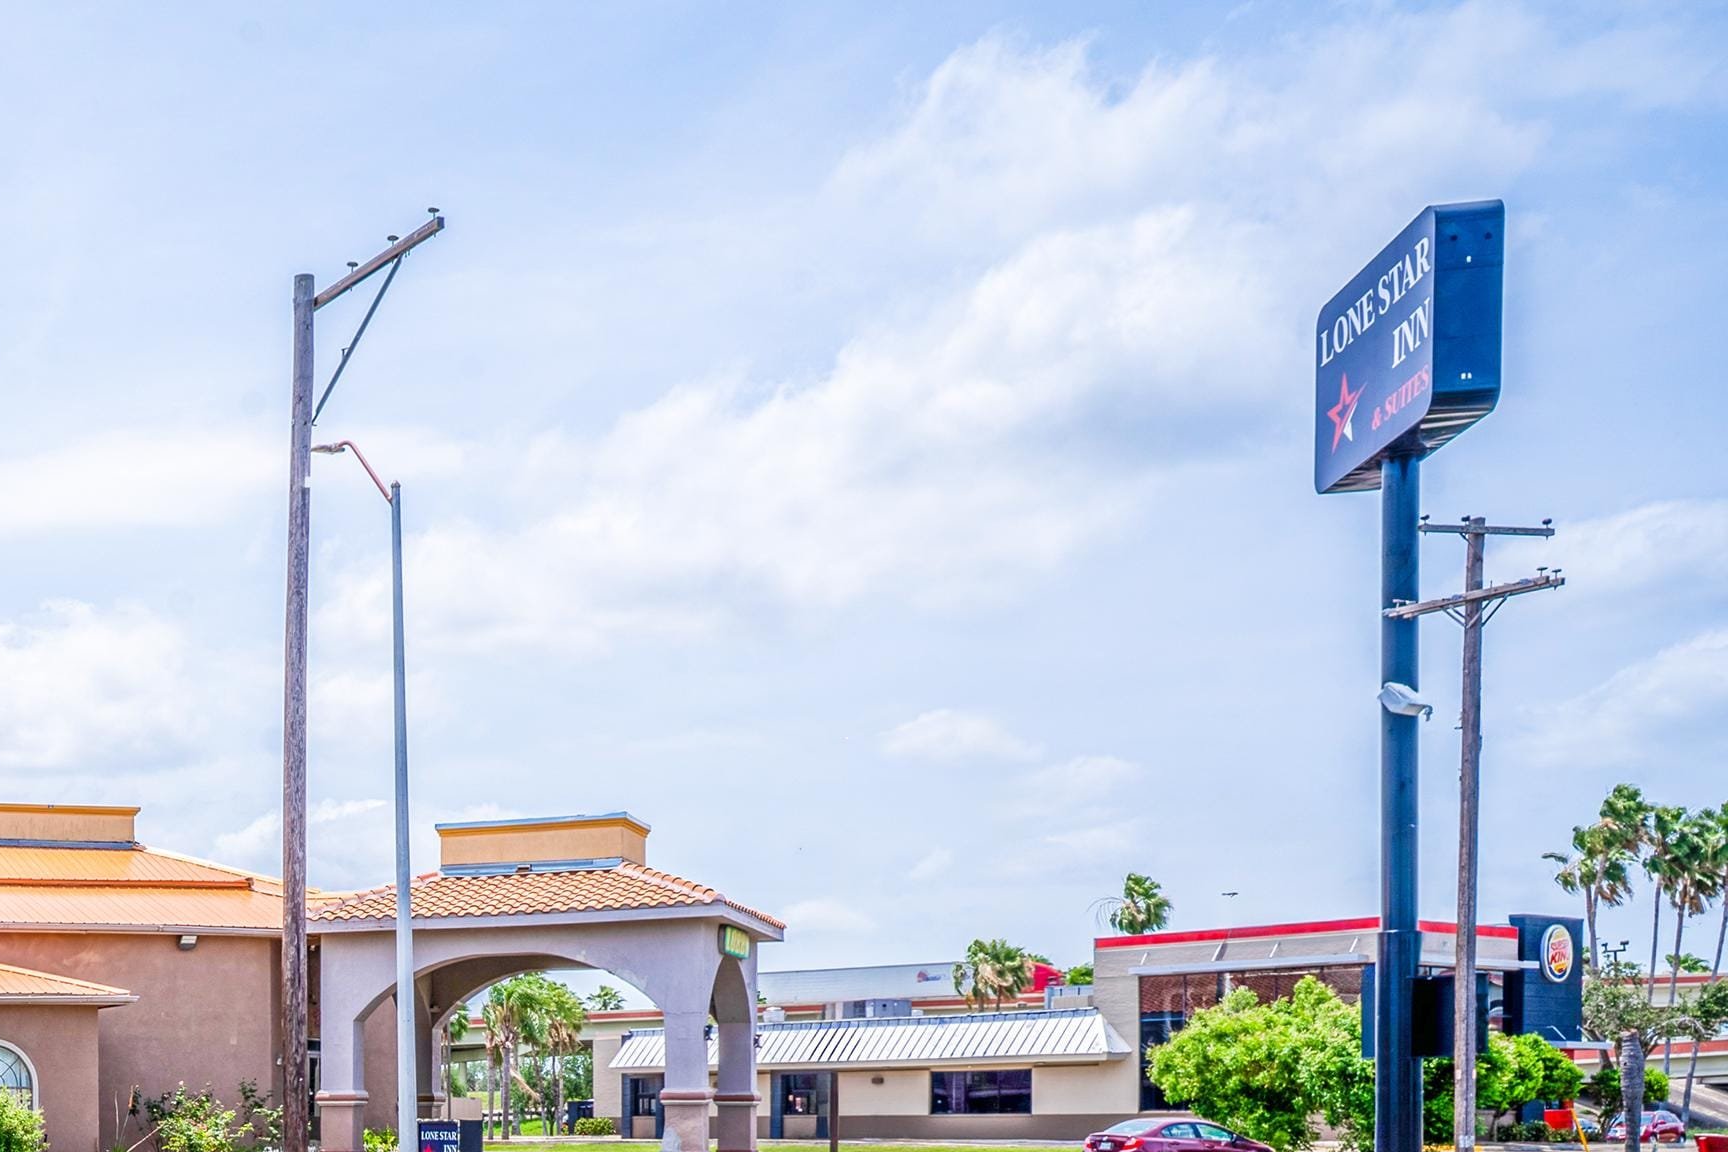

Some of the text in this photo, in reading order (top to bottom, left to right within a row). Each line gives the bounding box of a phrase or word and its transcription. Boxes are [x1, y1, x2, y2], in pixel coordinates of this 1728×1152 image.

[1320, 236, 1431, 368] LONE STAR
[1392, 297, 1431, 369] INN
[1371, 363, 1430, 431] & SUITES
[421, 1131, 457, 1141] LONE STAR
